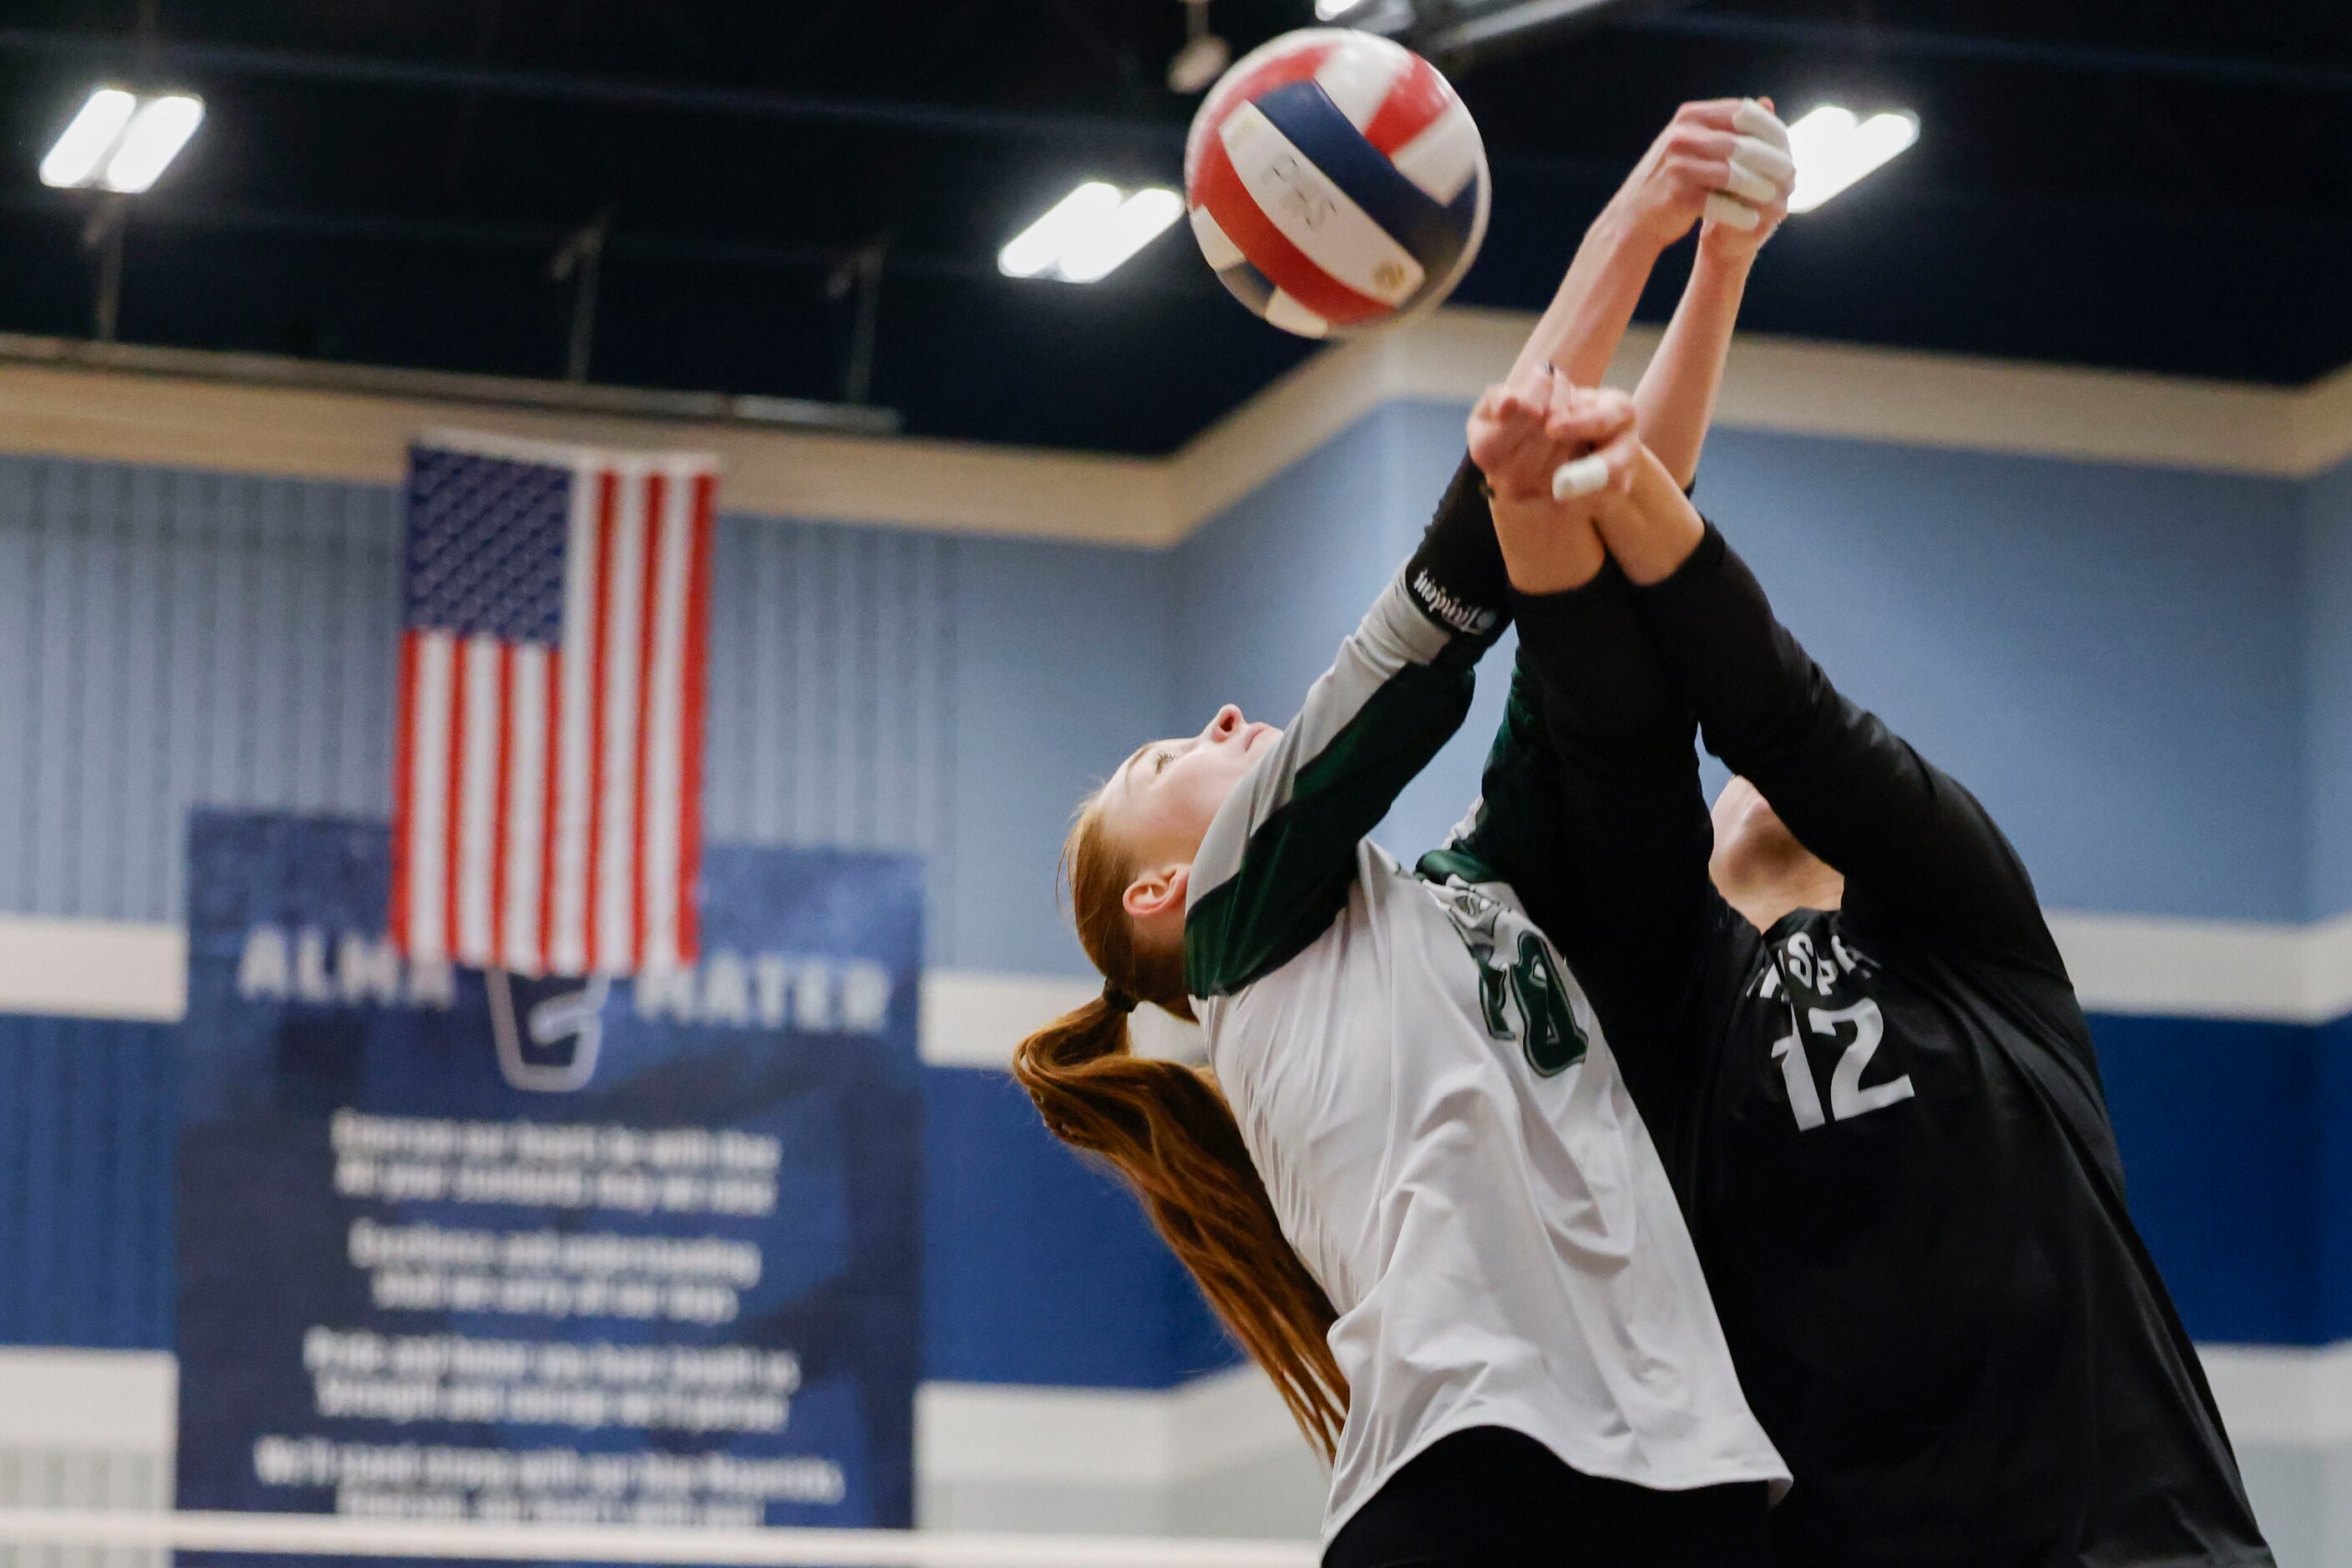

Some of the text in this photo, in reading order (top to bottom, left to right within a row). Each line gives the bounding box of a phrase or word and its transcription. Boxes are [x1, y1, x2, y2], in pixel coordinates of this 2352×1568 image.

[239, 924, 453, 1008] ALMA
[634, 948, 888, 1032] MATER
[1771, 997, 1915, 1132] 12
